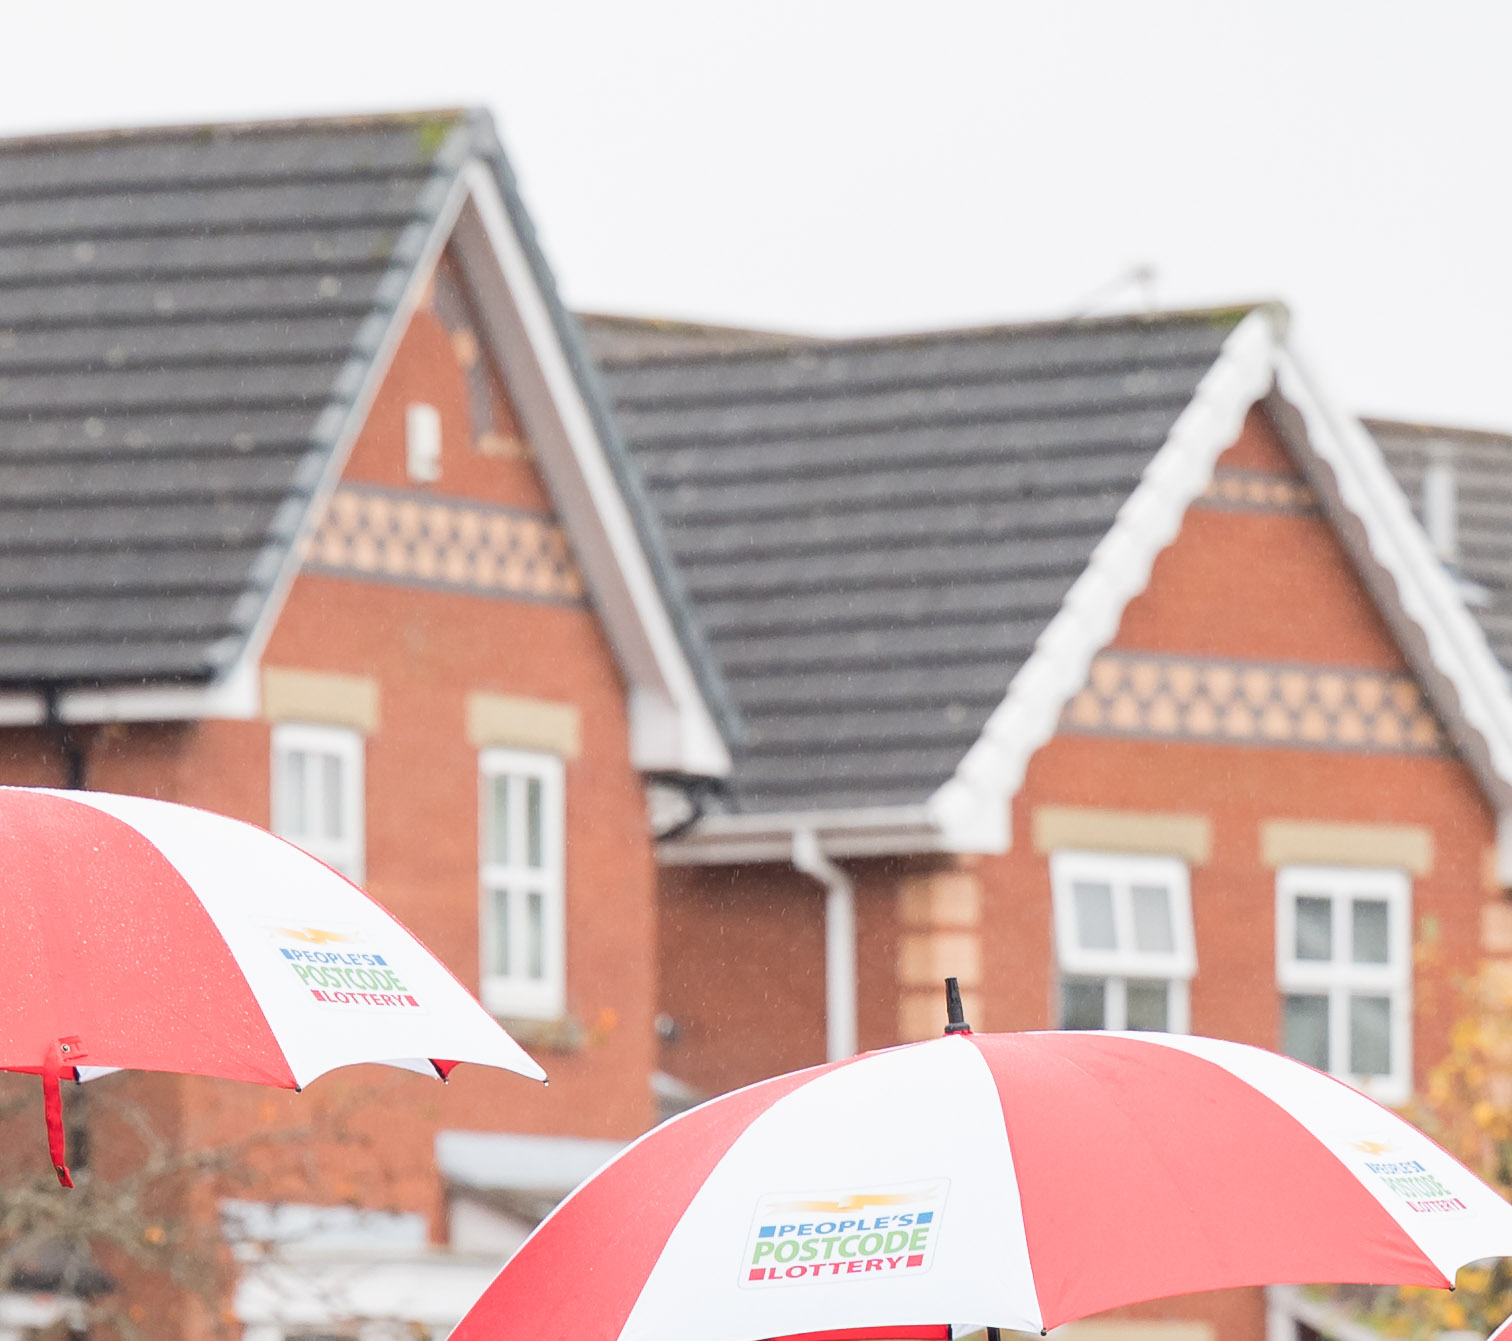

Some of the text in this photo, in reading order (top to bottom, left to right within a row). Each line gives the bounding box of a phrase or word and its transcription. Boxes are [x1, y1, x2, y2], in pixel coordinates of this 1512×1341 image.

[290, 949, 377, 966] PEOPLE'S
[291, 963, 408, 991] POSTCODE
[321, 990, 405, 1006] LOTTERY
[778, 1213, 914, 1236] PEOPLE'S
[752, 1228, 930, 1264] POSTCODE
[768, 1256, 905, 1280] LOTTERY
